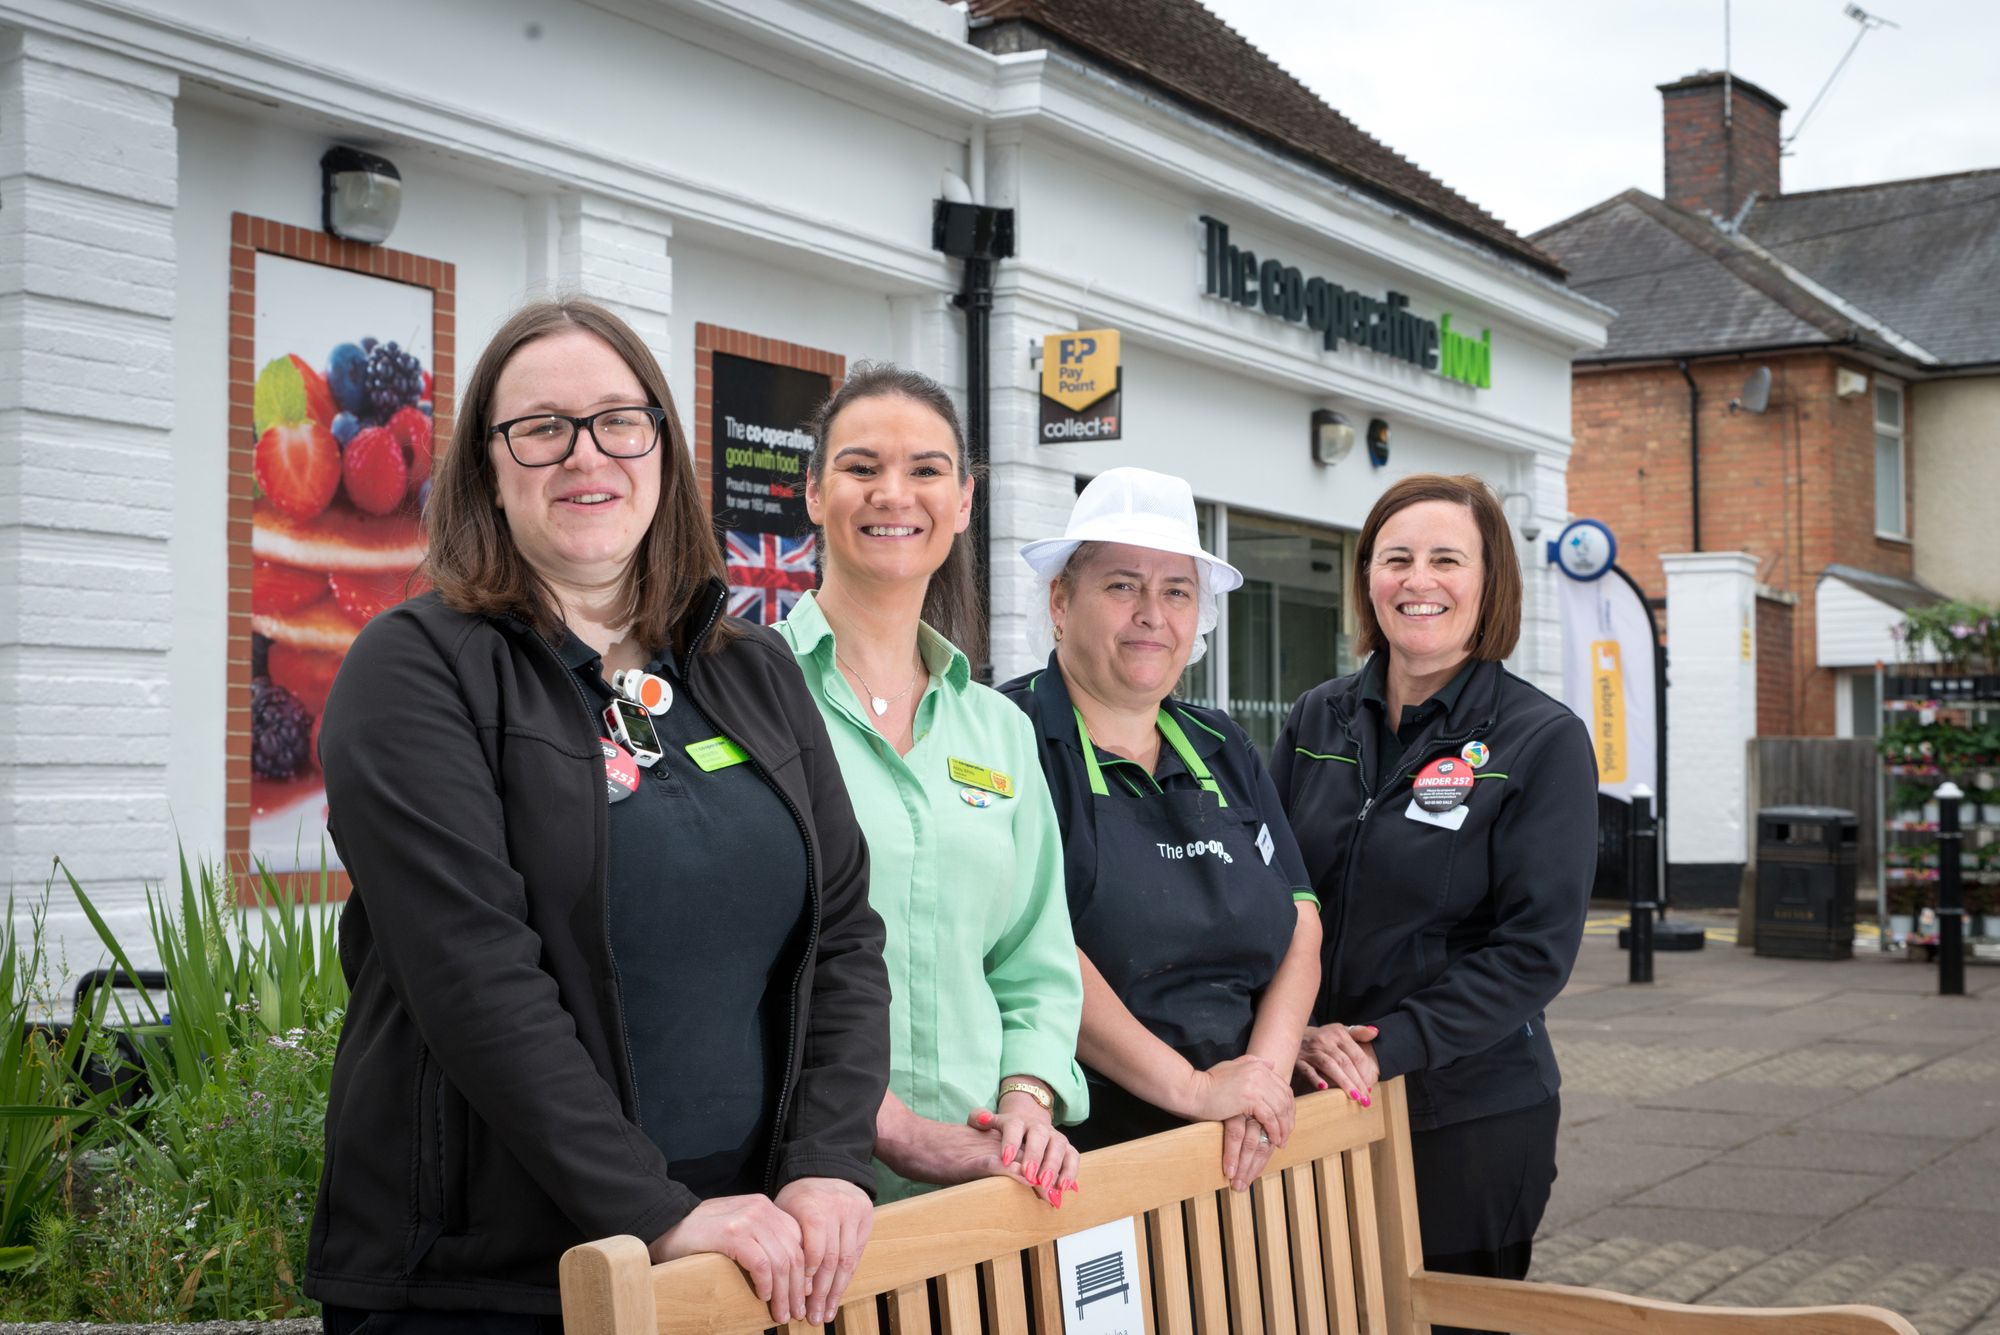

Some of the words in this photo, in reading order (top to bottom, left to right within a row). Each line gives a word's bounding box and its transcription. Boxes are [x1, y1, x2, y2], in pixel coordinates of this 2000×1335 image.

[1198, 215, 1258, 307] The
[1260, 258, 1439, 370] co-operative
[1440, 312, 1491, 389] food
[1059, 367, 1083, 381] Pay
[1059, 380, 1095, 392] Point
[725, 416, 745, 440] The
[746, 424, 815, 451] co-operative
[726, 447, 753, 468] good
[754, 449, 775, 470] with
[776, 451, 799, 474] food
[610, 769, 635, 785] 25?
[1418, 777, 1451, 785] UNDER
[1452, 777, 1470, 785] 25?
[1156, 843, 1183, 859] The
